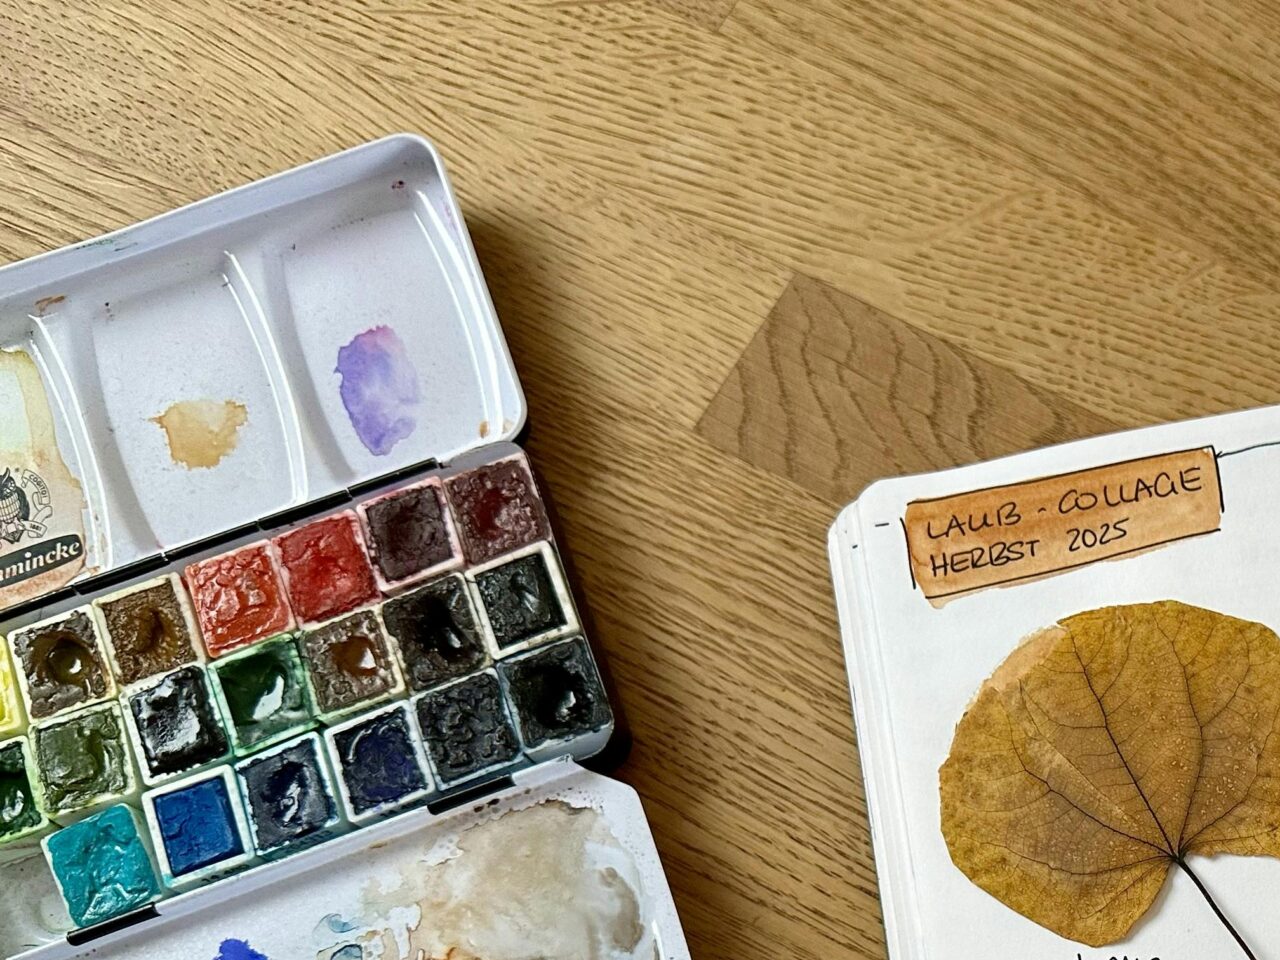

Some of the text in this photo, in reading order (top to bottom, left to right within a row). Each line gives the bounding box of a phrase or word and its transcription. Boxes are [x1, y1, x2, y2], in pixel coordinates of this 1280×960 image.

[926, 501, 1022, 540] LAUB
[1057, 466, 1204, 515] COLLAGE
[0, 541, 81, 581] mincke
[930, 517, 1130, 578] HERBST 2025
